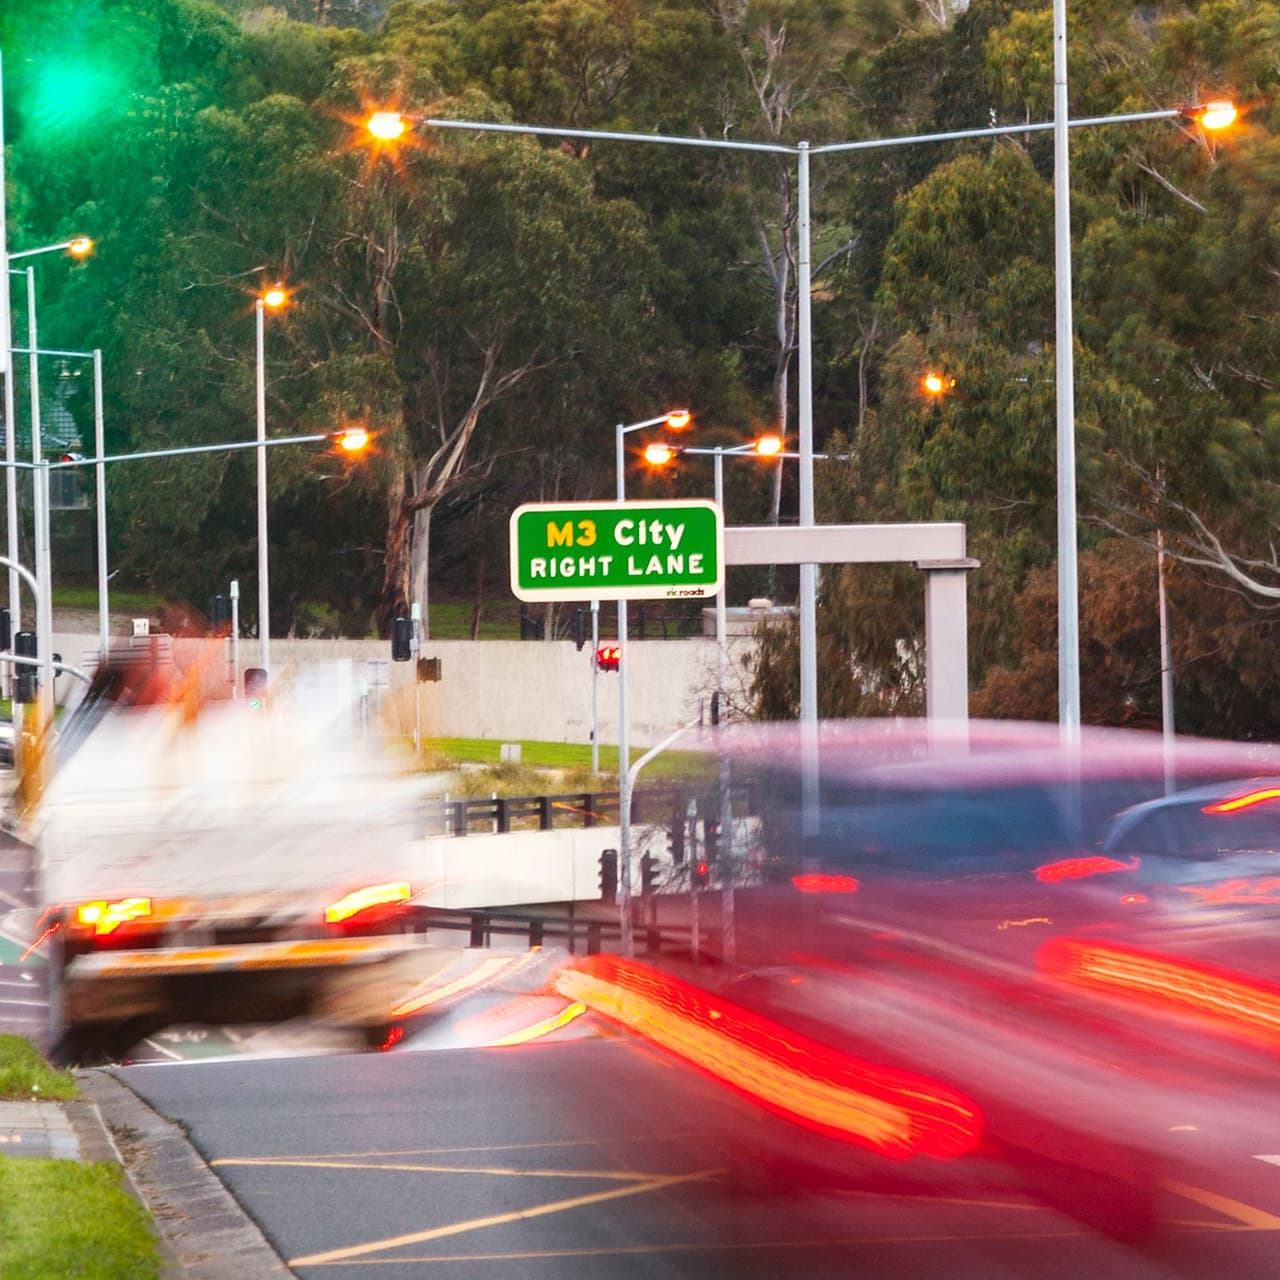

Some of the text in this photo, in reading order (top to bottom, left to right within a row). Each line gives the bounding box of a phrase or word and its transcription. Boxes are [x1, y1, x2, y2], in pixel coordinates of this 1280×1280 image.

[546, 518, 686, 551] M3 City
[530, 553, 705, 578] RIGHT LANE
